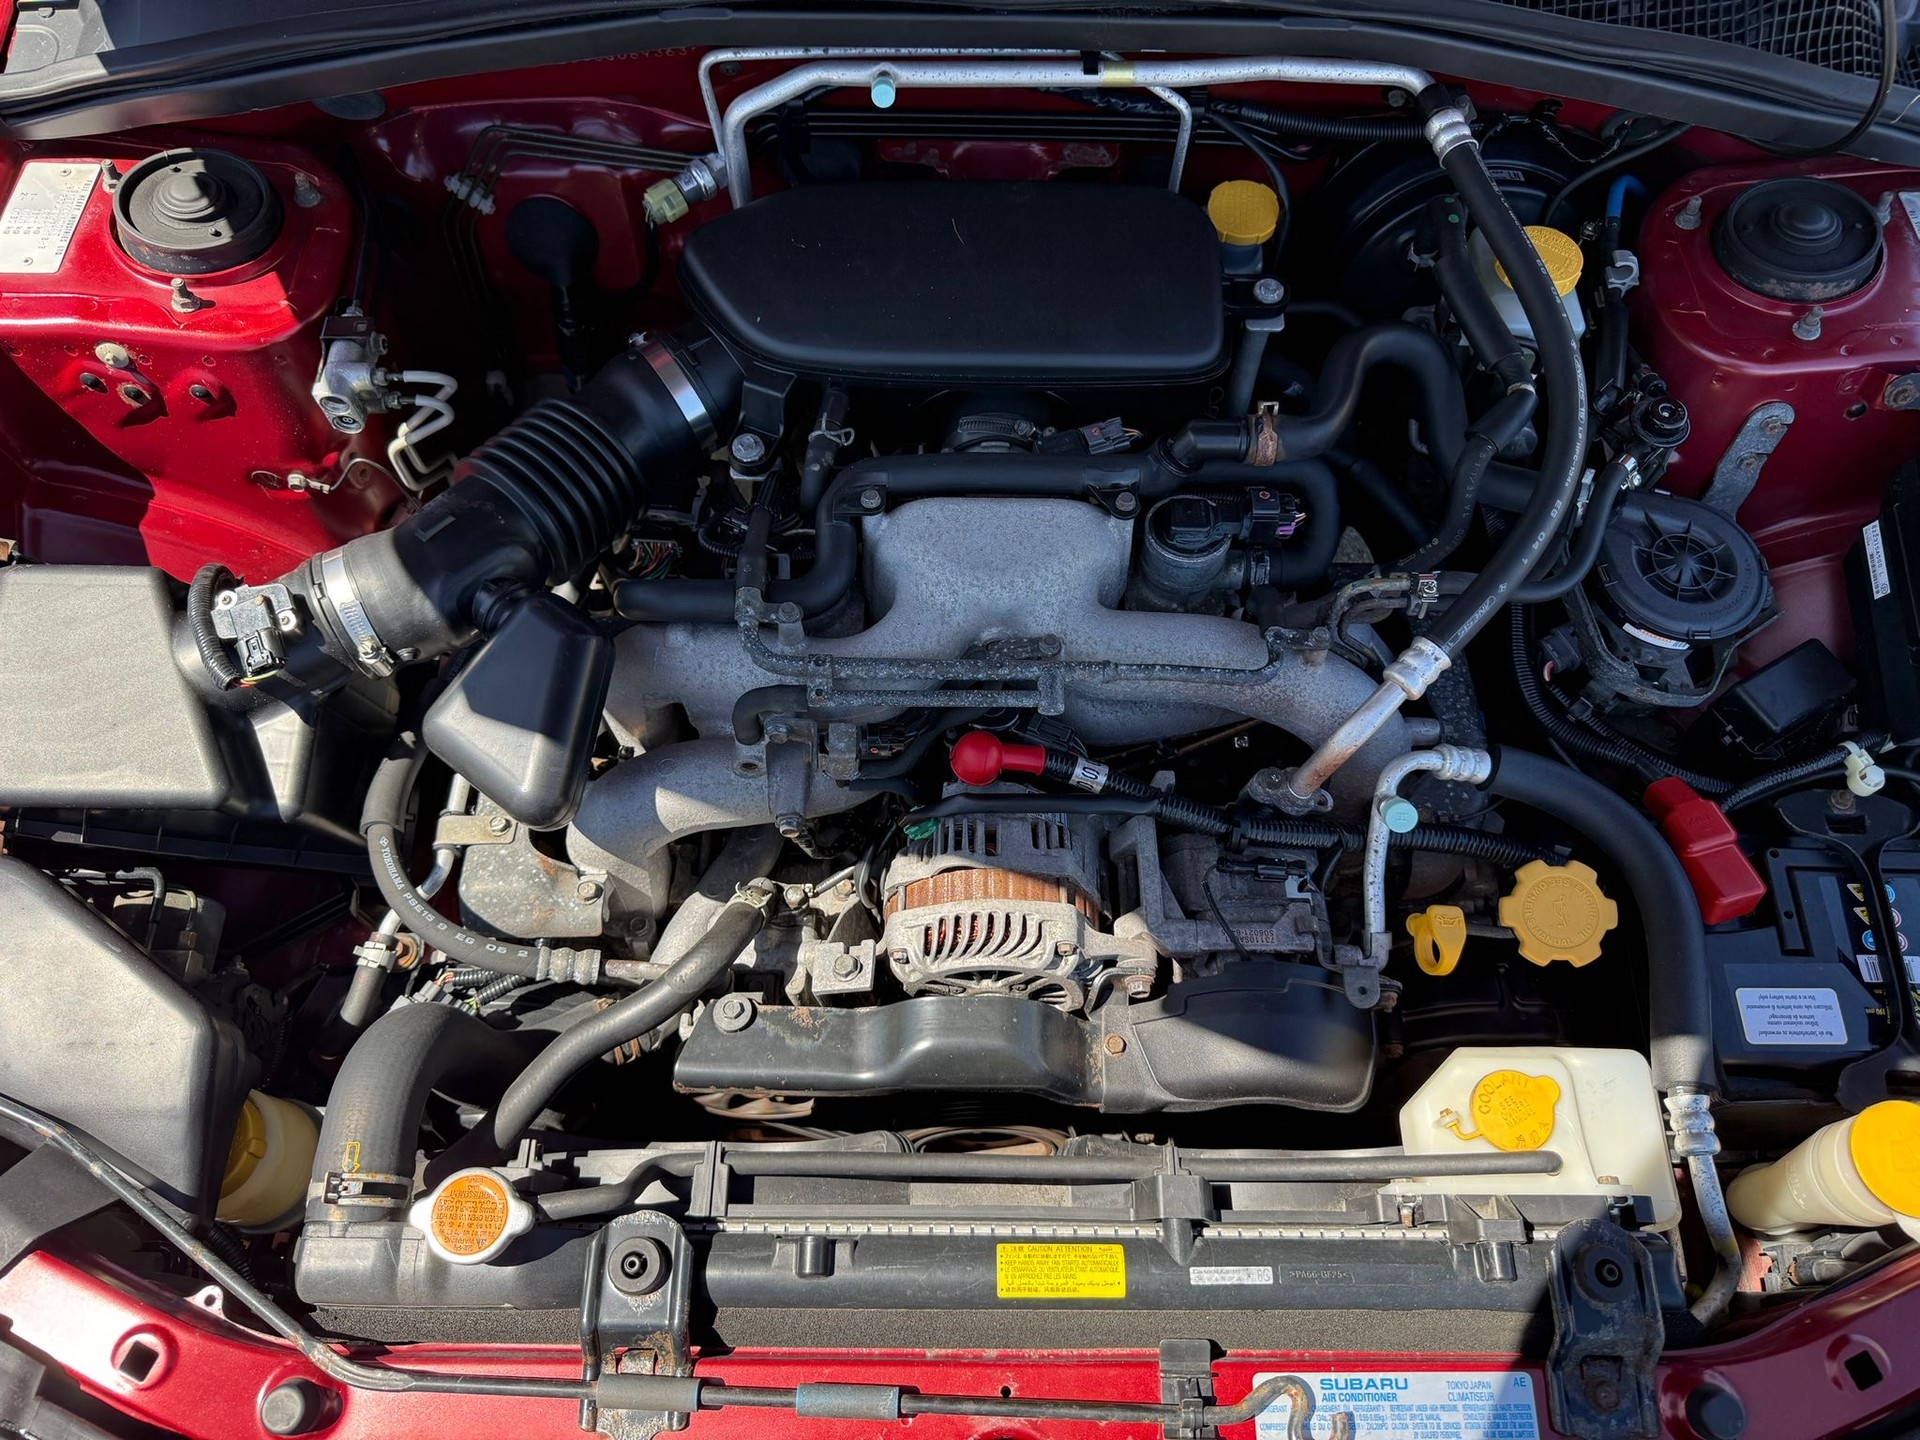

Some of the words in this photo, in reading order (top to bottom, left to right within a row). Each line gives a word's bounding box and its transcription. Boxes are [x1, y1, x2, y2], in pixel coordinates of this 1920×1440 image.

[1550, 499, 1562, 518] EG
[381, 847, 406, 890] YOKOHAMA
[403, 892, 436, 922] PSE15
[455, 932, 476, 945] EG
[1225, 936, 1275, 944] 73110SA1
[1478, 1073, 1529, 1114] COOLANT
[1320, 1378, 1408, 1390] SUBARU
[1446, 1381, 1468, 1390] TOKYO
[1470, 1381, 1491, 1390] JAPAN
[1513, 1377, 1527, 1387] AE
[1322, 1393, 1336, 1402] AIR
[1339, 1392, 1398, 1403] CONDITIONER
[1447, 1392, 1495, 1402] CLIMATISEUR
